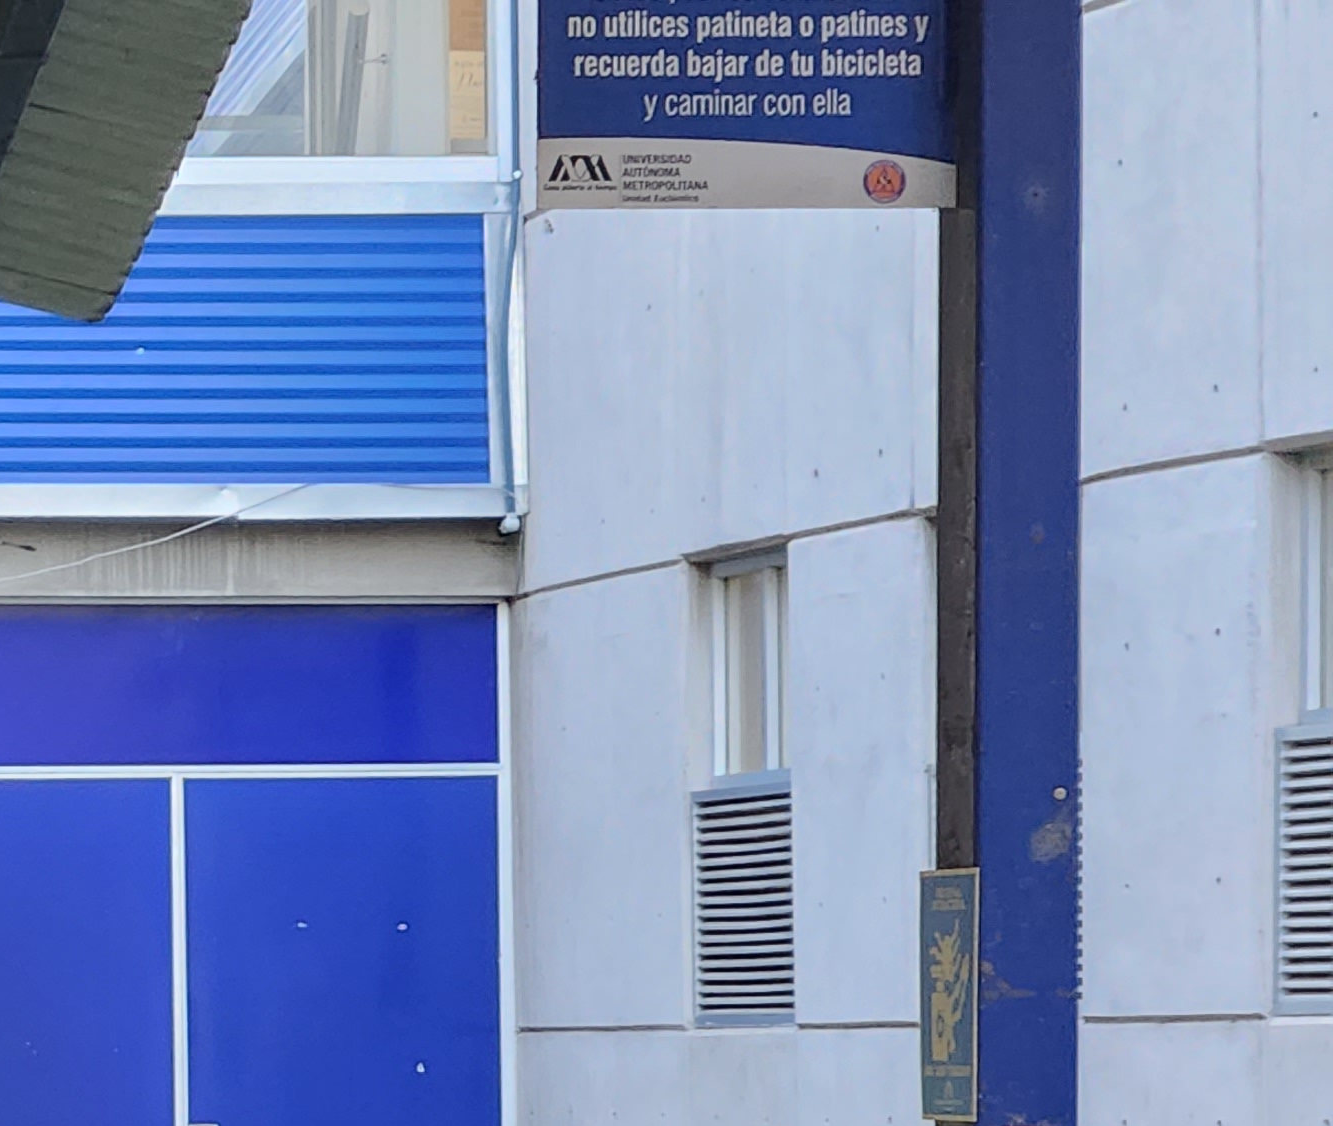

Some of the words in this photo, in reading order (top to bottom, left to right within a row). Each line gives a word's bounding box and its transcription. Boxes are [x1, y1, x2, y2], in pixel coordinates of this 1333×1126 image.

[567, 15, 597, 38] no
[604, 9, 689, 38] utilices
[696, 9, 792, 43] patineta
[799, 15, 814, 38] o
[821, 9, 908, 43] patines
[914, 15, 929, 43] y
[573, 48, 680, 77] recuerda
[686, 48, 750, 83] bajar
[755, 48, 784, 77] de
[791, 49, 814, 77] tu
[821, 48, 922, 77] bicicleta
[643, 94, 658, 122] y
[665, 88, 757, 117] caminar
[764, 93, 805, 117] con
[812, 87, 851, 116] ella
[622, 154, 692, 165] UNIVERSIDAD
[622, 180, 709, 191] METROPOLITANA
